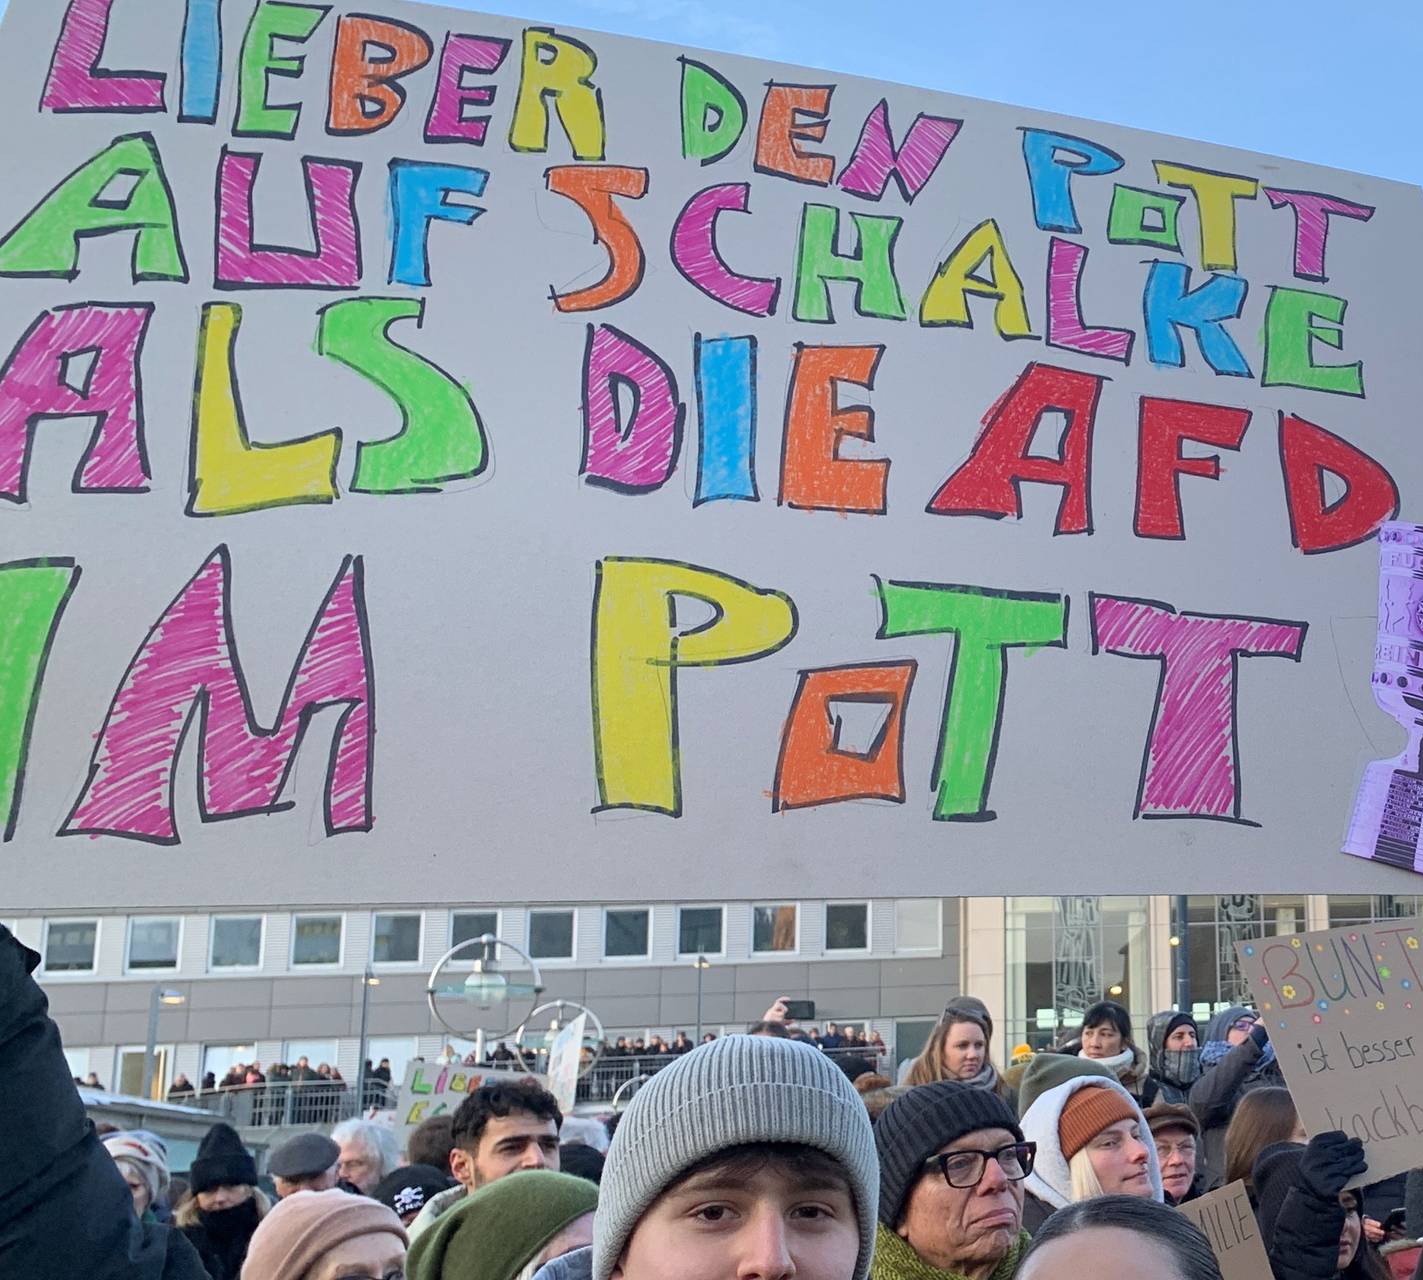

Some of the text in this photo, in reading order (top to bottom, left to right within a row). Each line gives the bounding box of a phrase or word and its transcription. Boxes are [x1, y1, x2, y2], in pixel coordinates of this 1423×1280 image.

[0, 131, 1366, 399] AUF SCHALKE
[38, 0, 1376, 283] LIEBER DEN POTT
[0, 296, 1400, 556] ALS DIE AFD
[590, 555, 1310, 827] POTT
[1262, 928, 1423, 1009] BUNT
[1297, 1037, 1335, 1074] ist
[1340, 1031, 1416, 1069] besser
